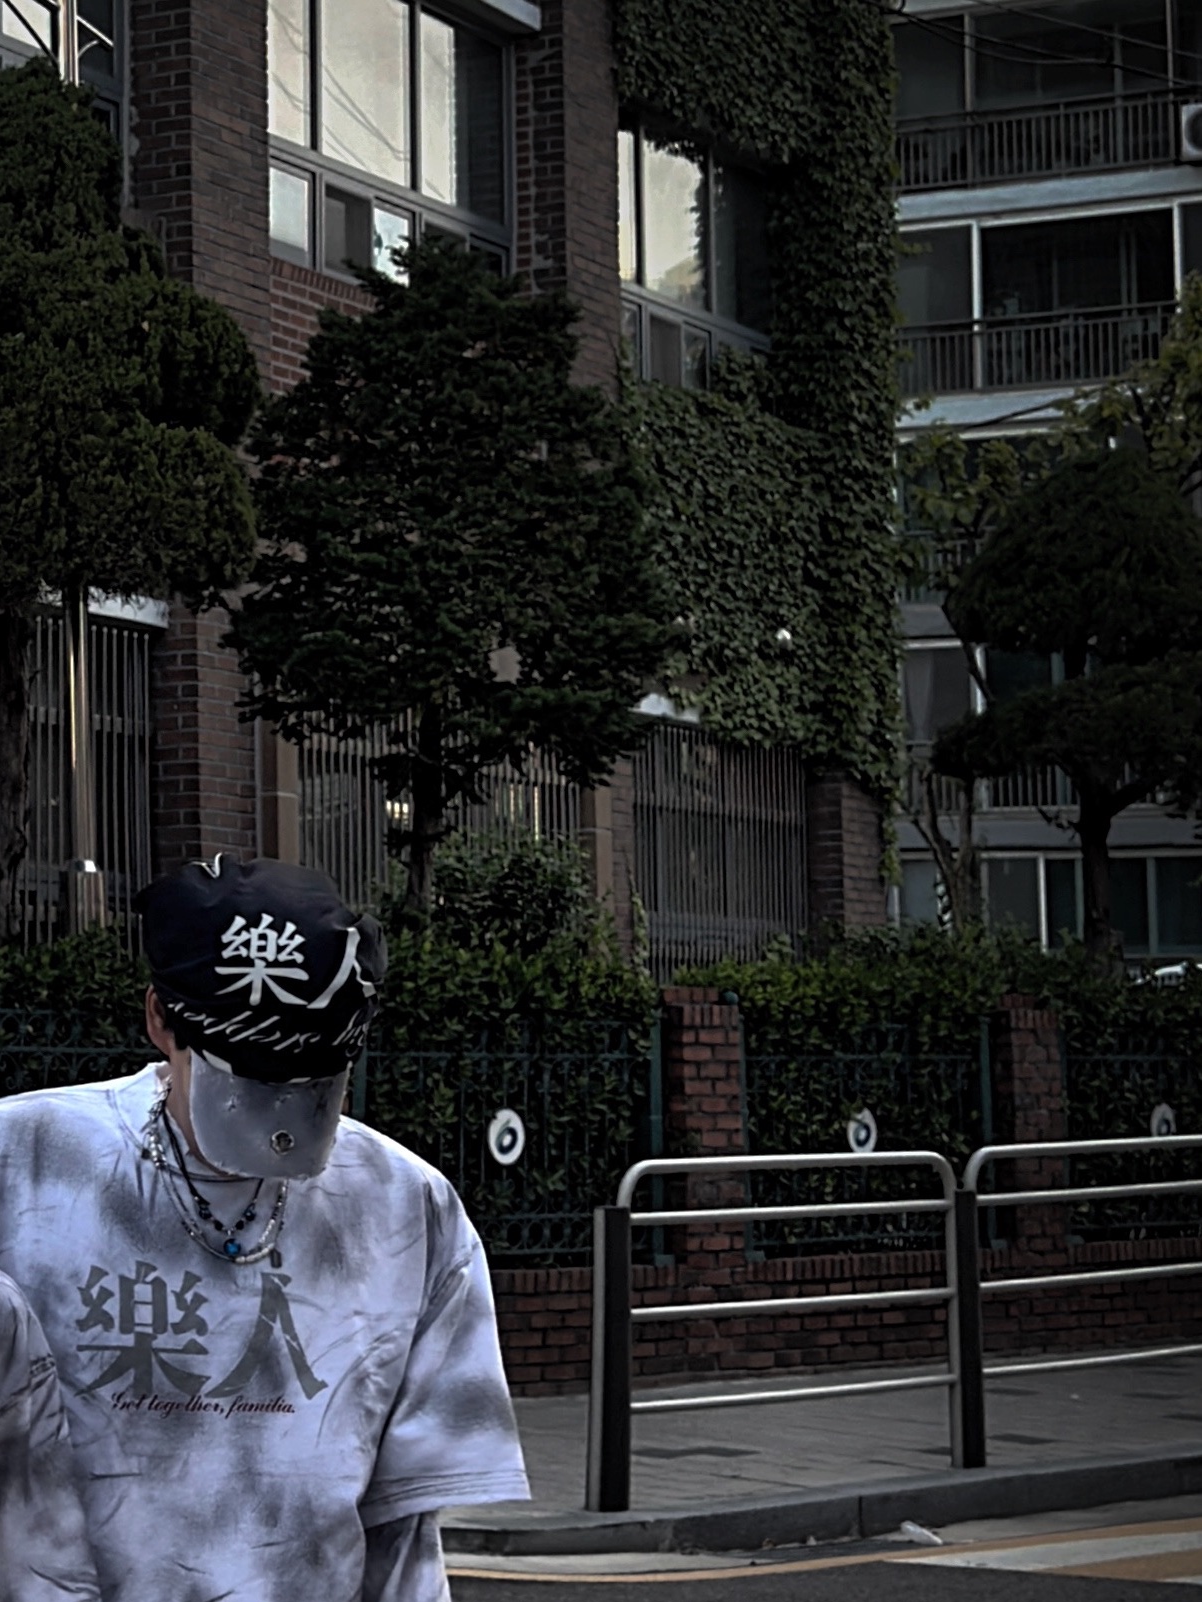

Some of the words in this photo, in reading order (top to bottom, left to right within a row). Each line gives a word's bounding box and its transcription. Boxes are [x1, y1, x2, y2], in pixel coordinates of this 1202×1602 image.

[74, 1260, 329, 1401] 樂人
[111, 1390, 147, 1411] Get
[147, 1394, 225, 1419] together,
[225, 1394, 296, 1419] familia.
